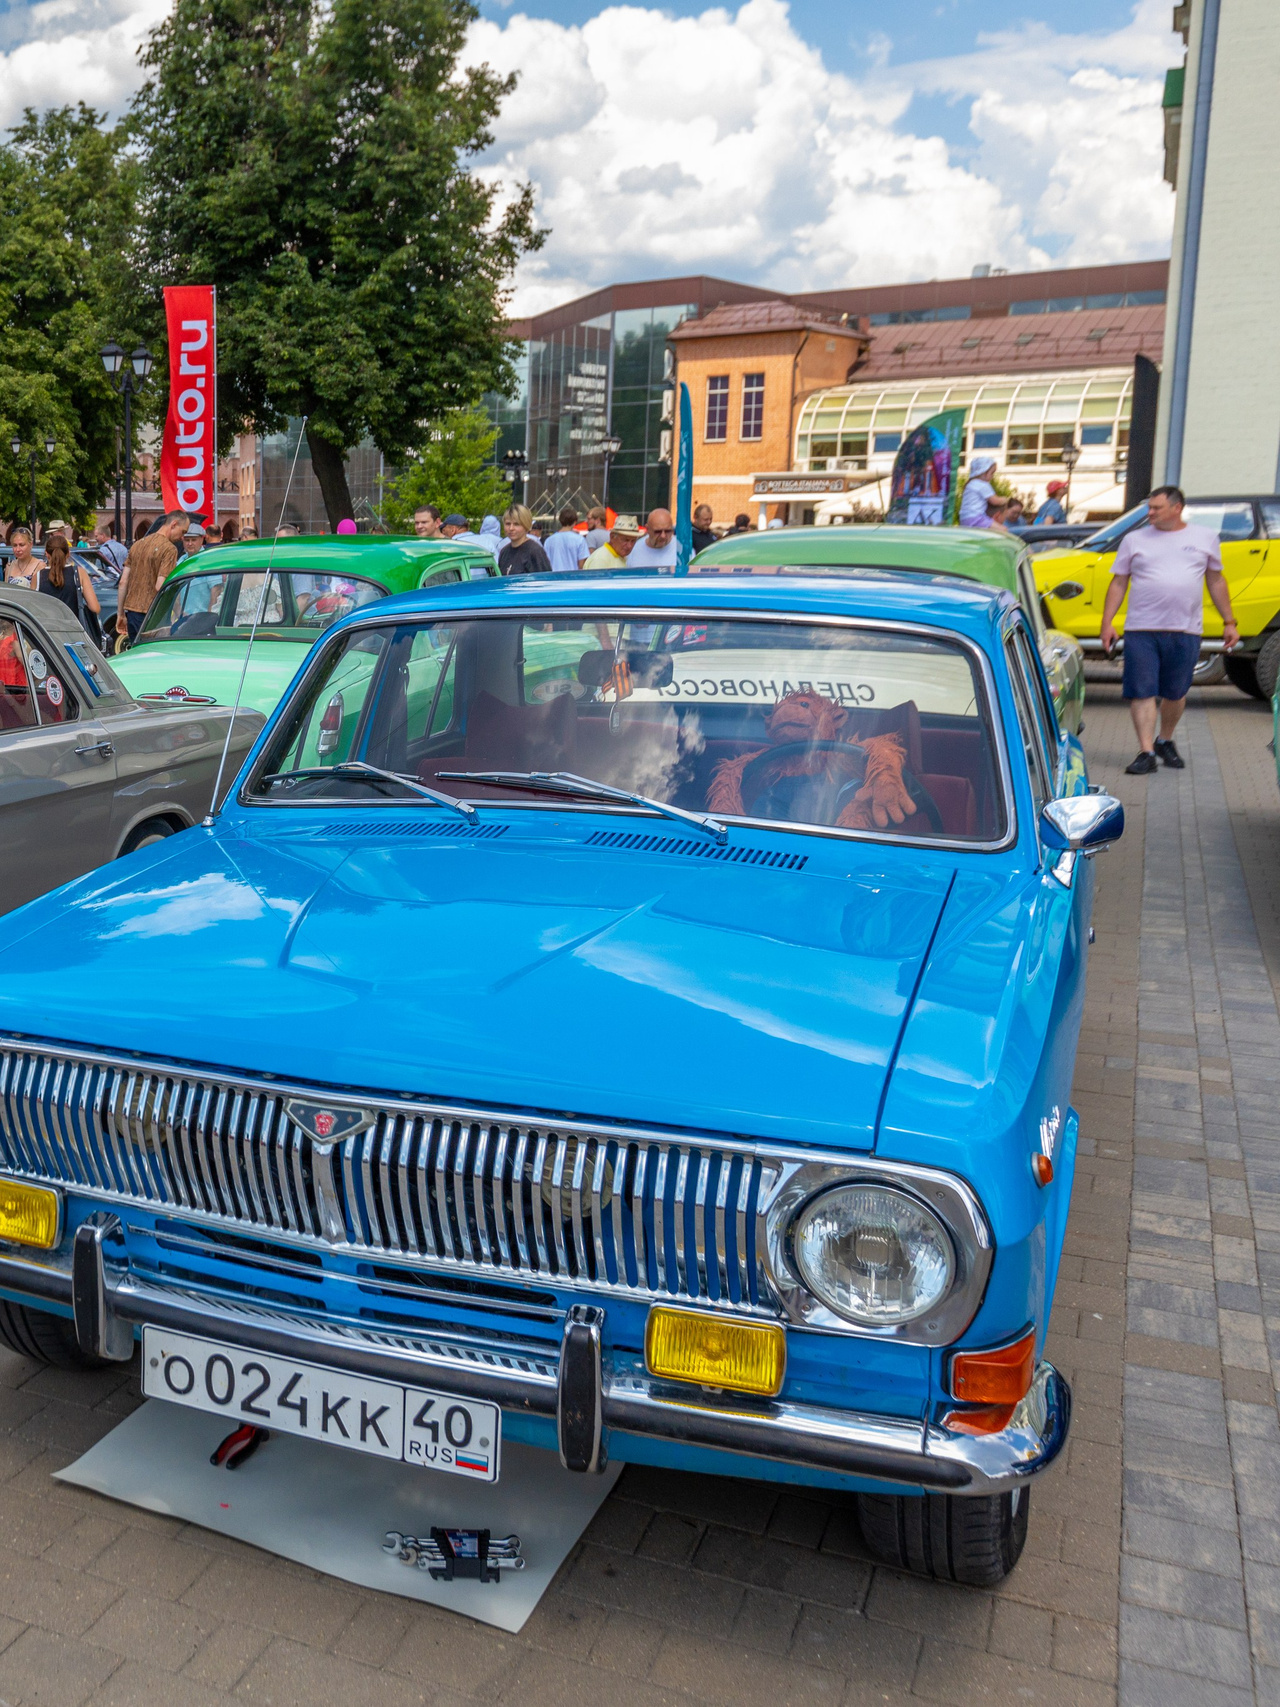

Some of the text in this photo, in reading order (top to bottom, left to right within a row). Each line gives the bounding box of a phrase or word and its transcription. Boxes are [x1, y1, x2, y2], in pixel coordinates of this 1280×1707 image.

[175, 320, 208, 512] auto.ru
[412, 1399, 473, 1448] 40
[409, 1440, 453, 1464] RUS
